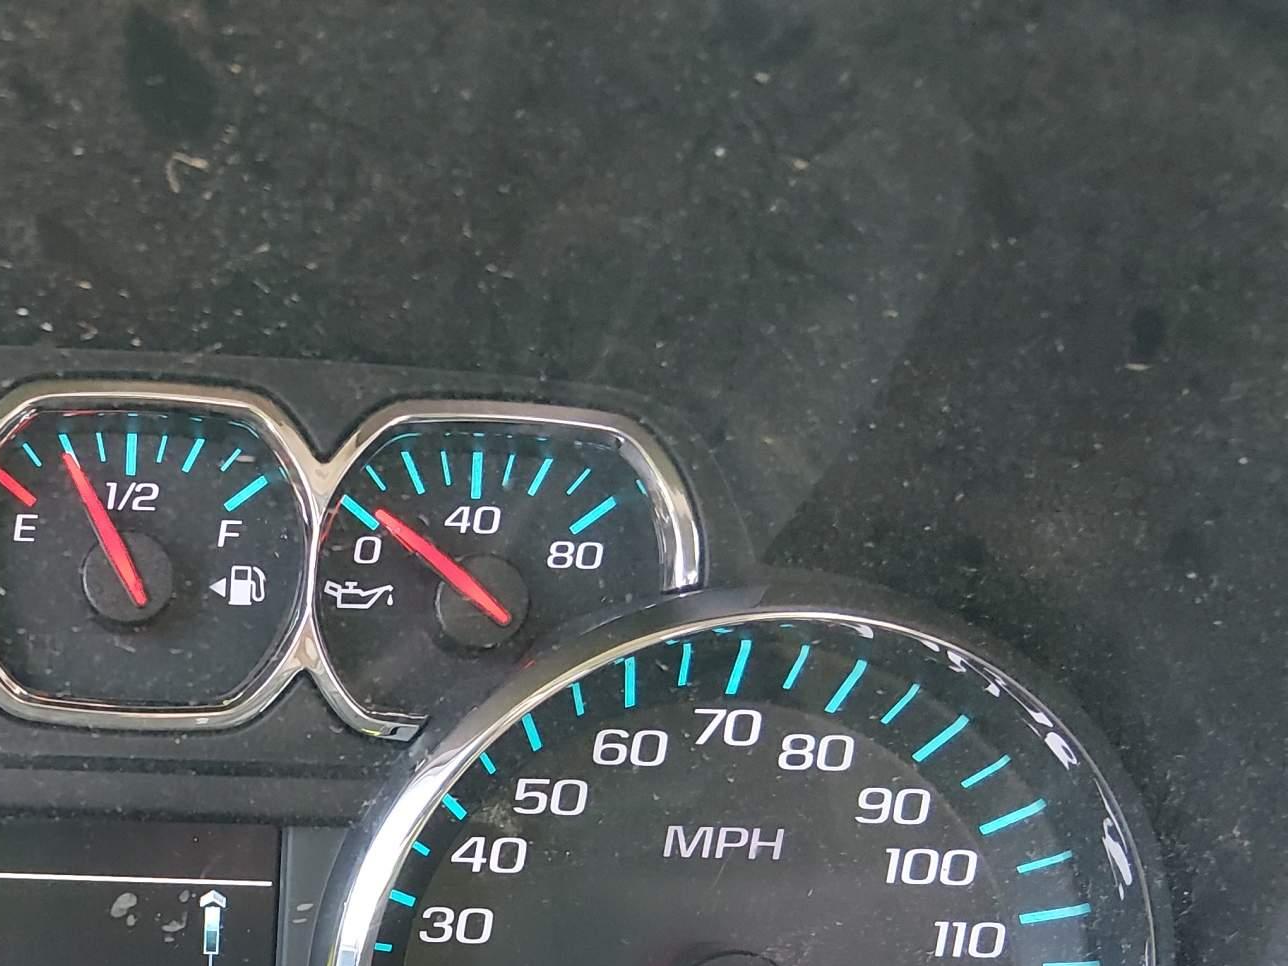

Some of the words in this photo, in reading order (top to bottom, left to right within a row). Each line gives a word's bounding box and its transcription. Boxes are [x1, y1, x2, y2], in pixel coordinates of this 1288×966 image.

[106, 482, 159, 511] 1/2
[14, 515, 36, 541] E
[219, 520, 242, 547] F
[445, 507, 500, 534] 40
[354, 537, 380, 563] 0
[547, 542, 602, 570] 80
[693, 709, 761, 747] 70
[594, 730, 667, 767] 60
[778, 735, 853, 772] 80
[514, 780, 587, 816] 50
[855, 789, 930, 824] 90
[451, 837, 526, 873] 40
[664, 826, 784, 860] MPH
[886, 848, 977, 885] 100
[419, 908, 493, 944] 30
[934, 921, 1005, 958] 110
